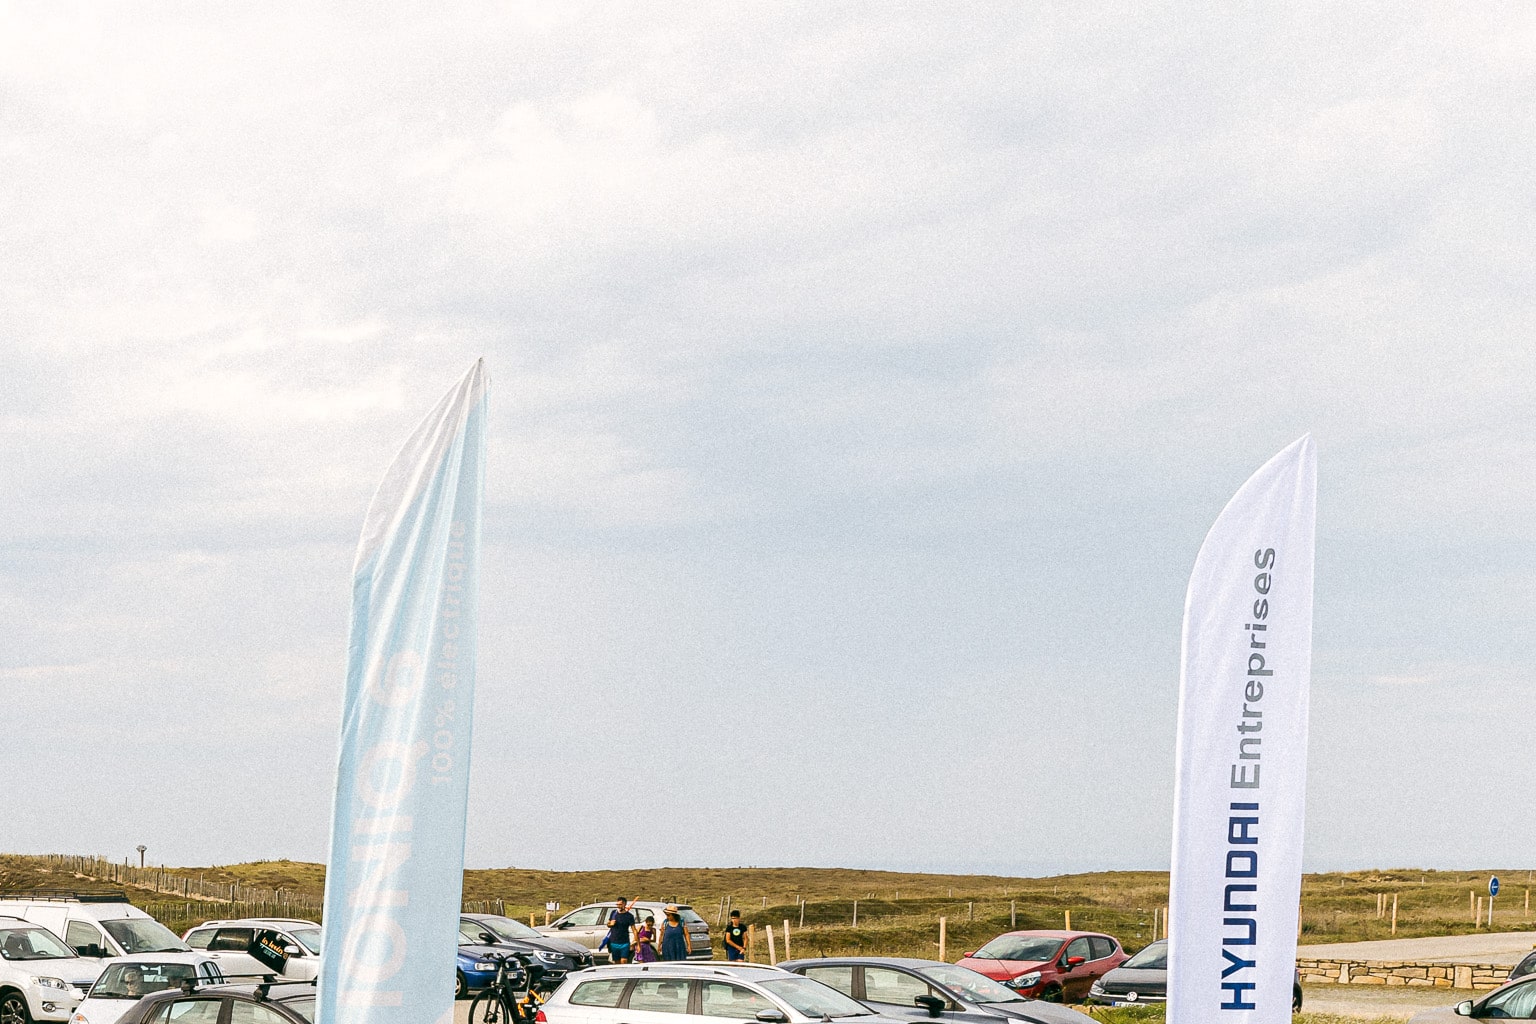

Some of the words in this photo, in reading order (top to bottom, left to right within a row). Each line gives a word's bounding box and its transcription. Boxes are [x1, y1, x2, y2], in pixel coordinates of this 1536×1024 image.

[1230, 548, 1276, 789] Entreprises
[340, 738, 430, 1007] IONIQ
[1221, 802, 1259, 1010] HYUNDAI
